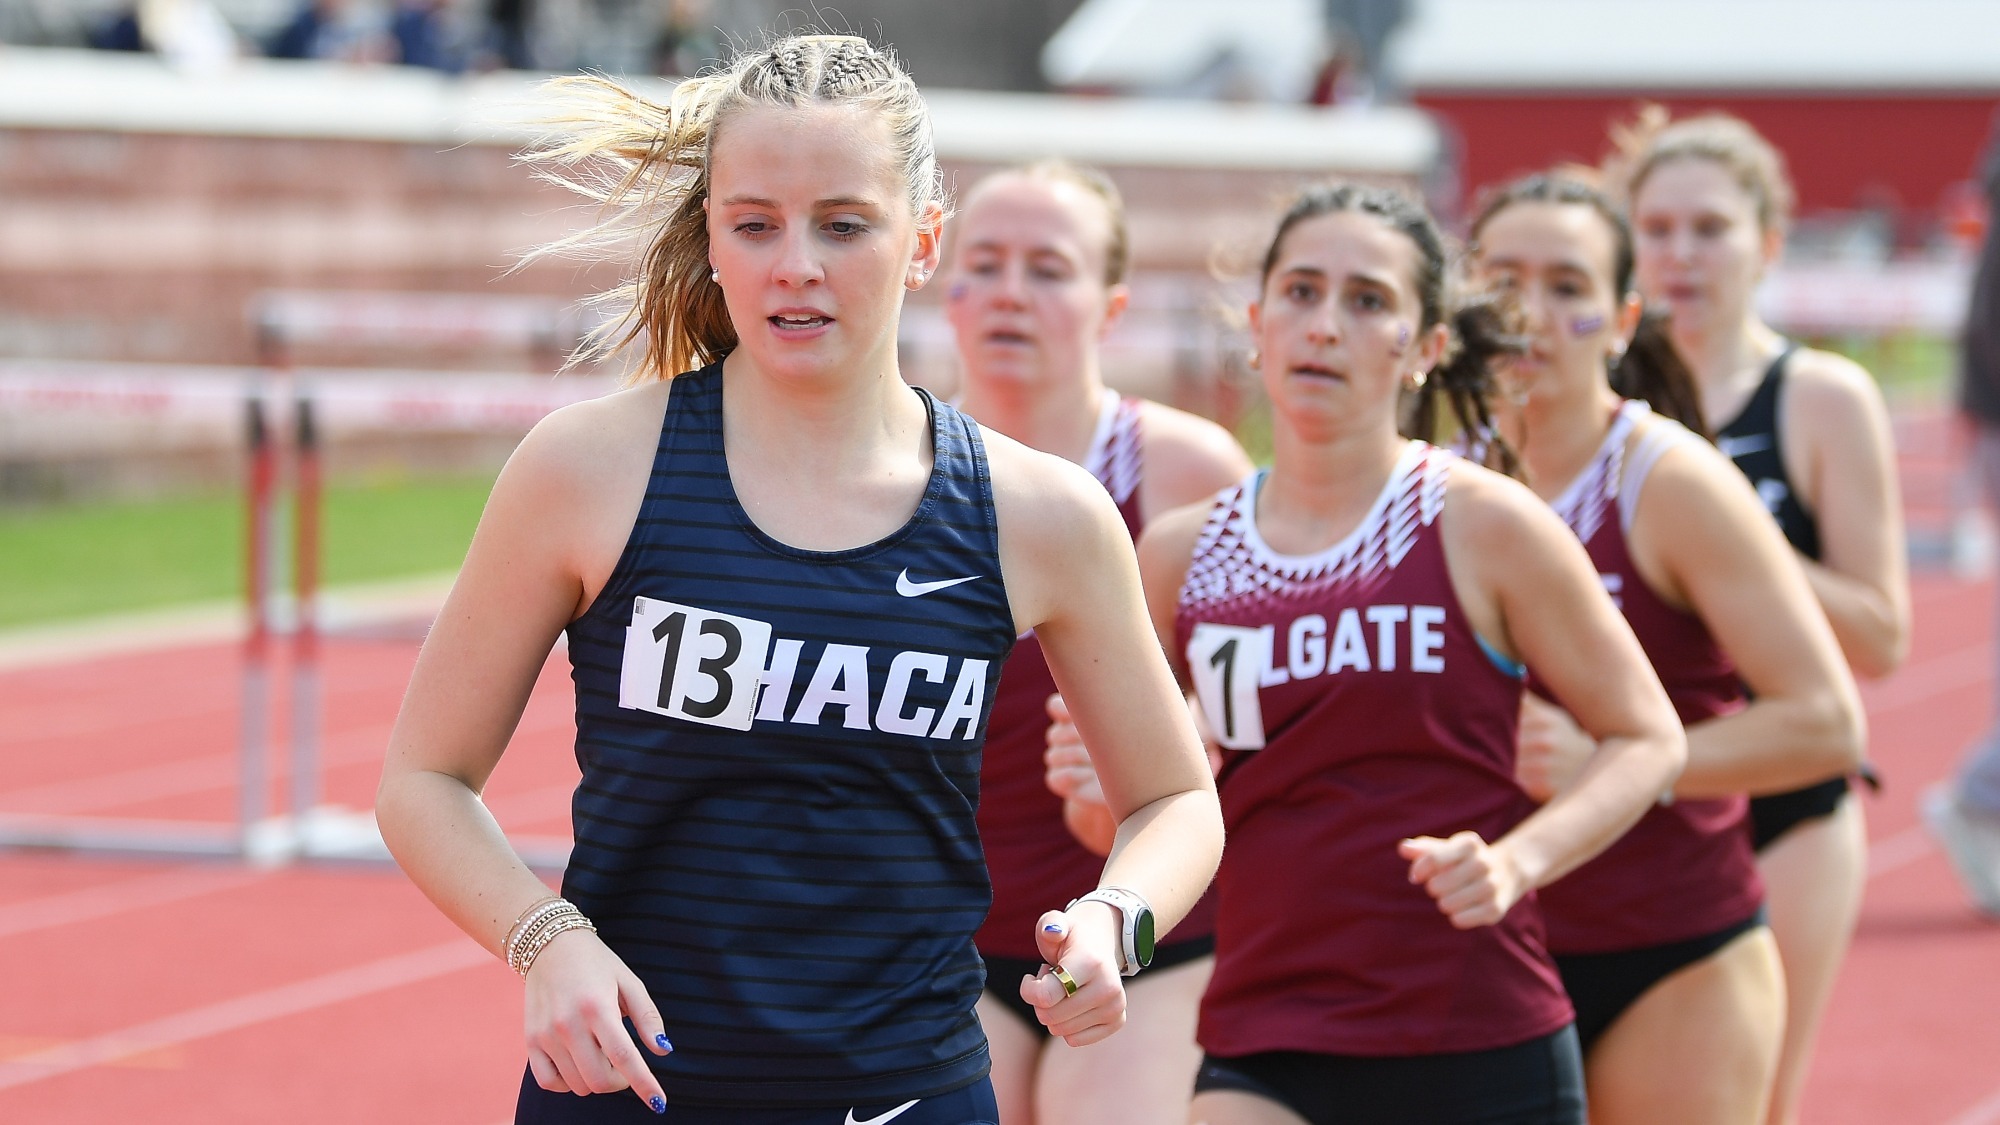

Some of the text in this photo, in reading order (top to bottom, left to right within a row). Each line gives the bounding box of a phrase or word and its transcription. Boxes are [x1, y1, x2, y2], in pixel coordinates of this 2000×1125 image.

[652, 611, 742, 719] 13
[1210, 639, 1238, 738] 1
[1259, 605, 1445, 688] LGATE
